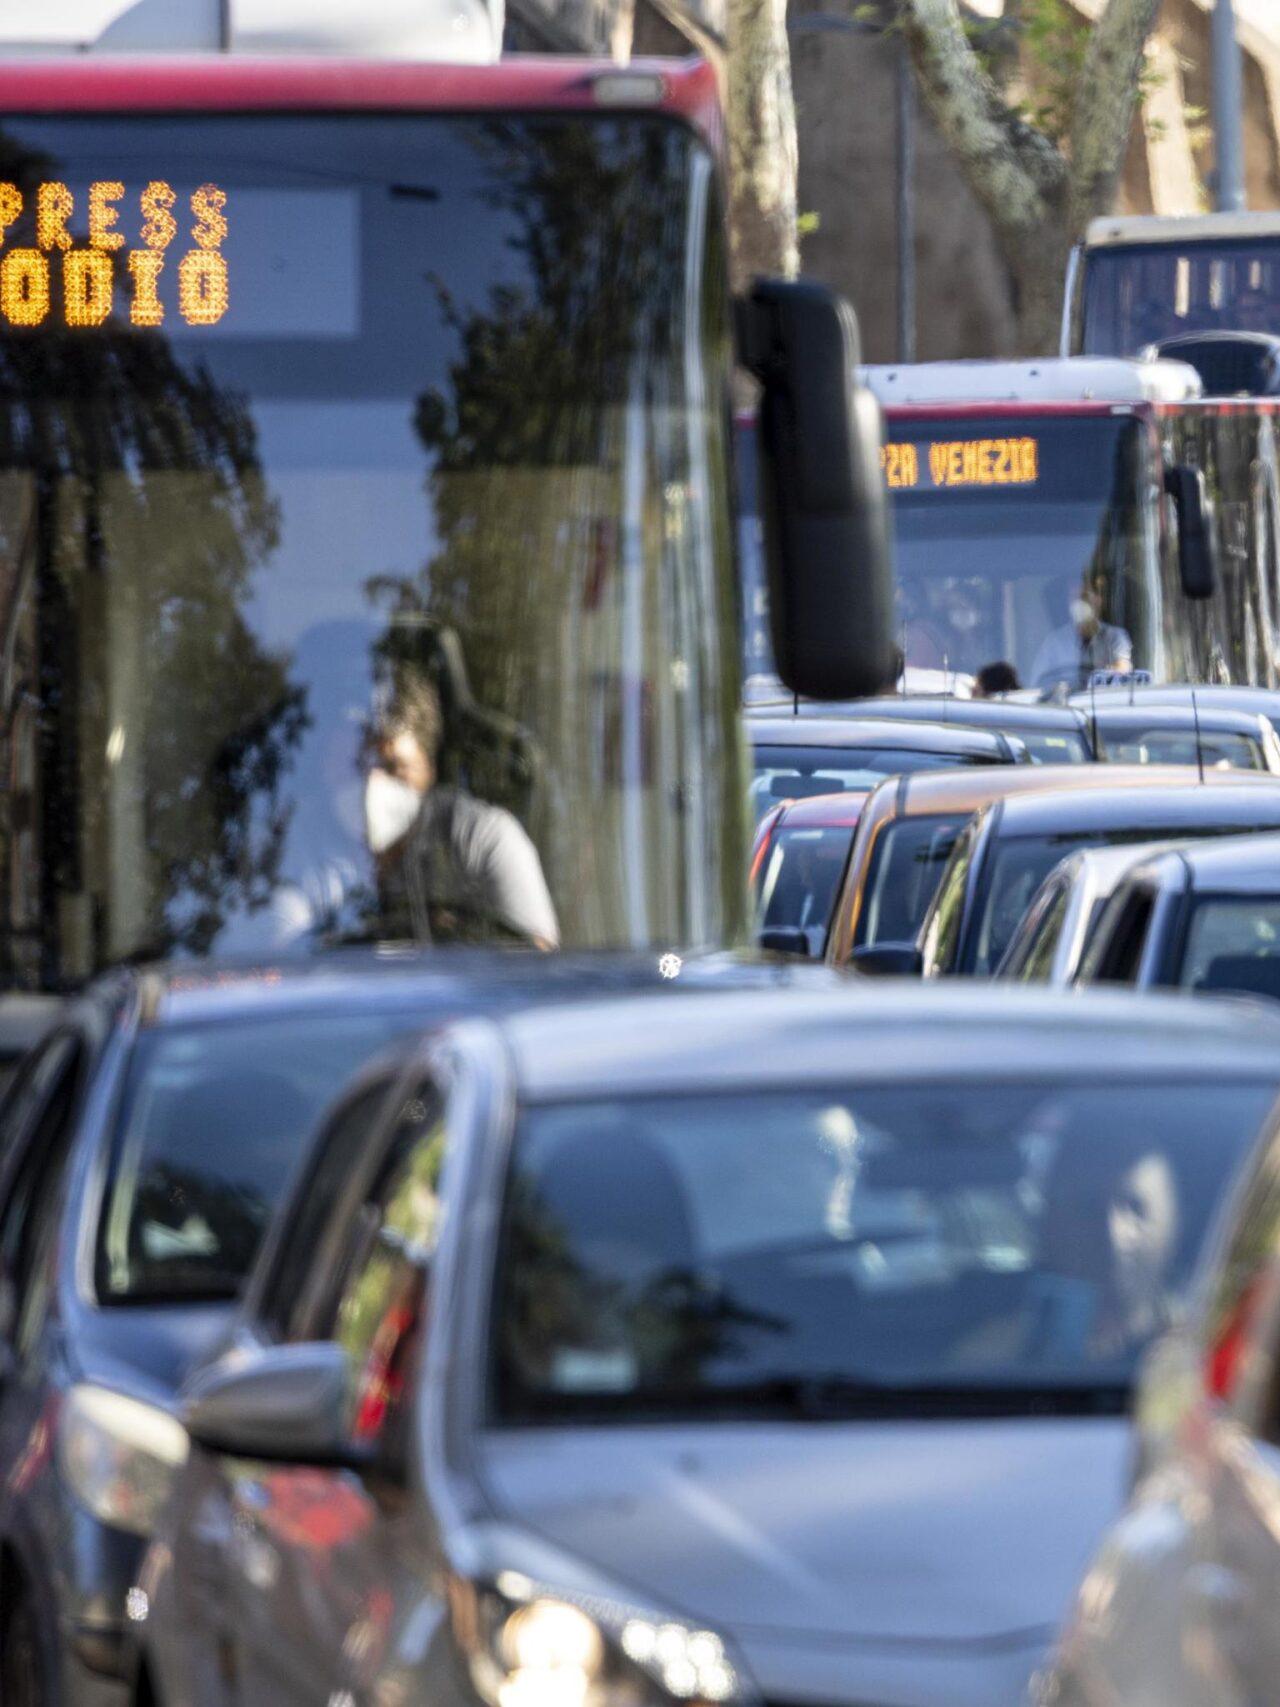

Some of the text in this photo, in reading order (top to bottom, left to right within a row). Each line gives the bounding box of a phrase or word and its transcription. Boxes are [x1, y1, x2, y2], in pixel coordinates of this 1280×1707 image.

[0, 180, 228, 250] PRESS
[0, 248, 229, 326] ODIO
[929, 437, 1038, 486] VENEZIA
